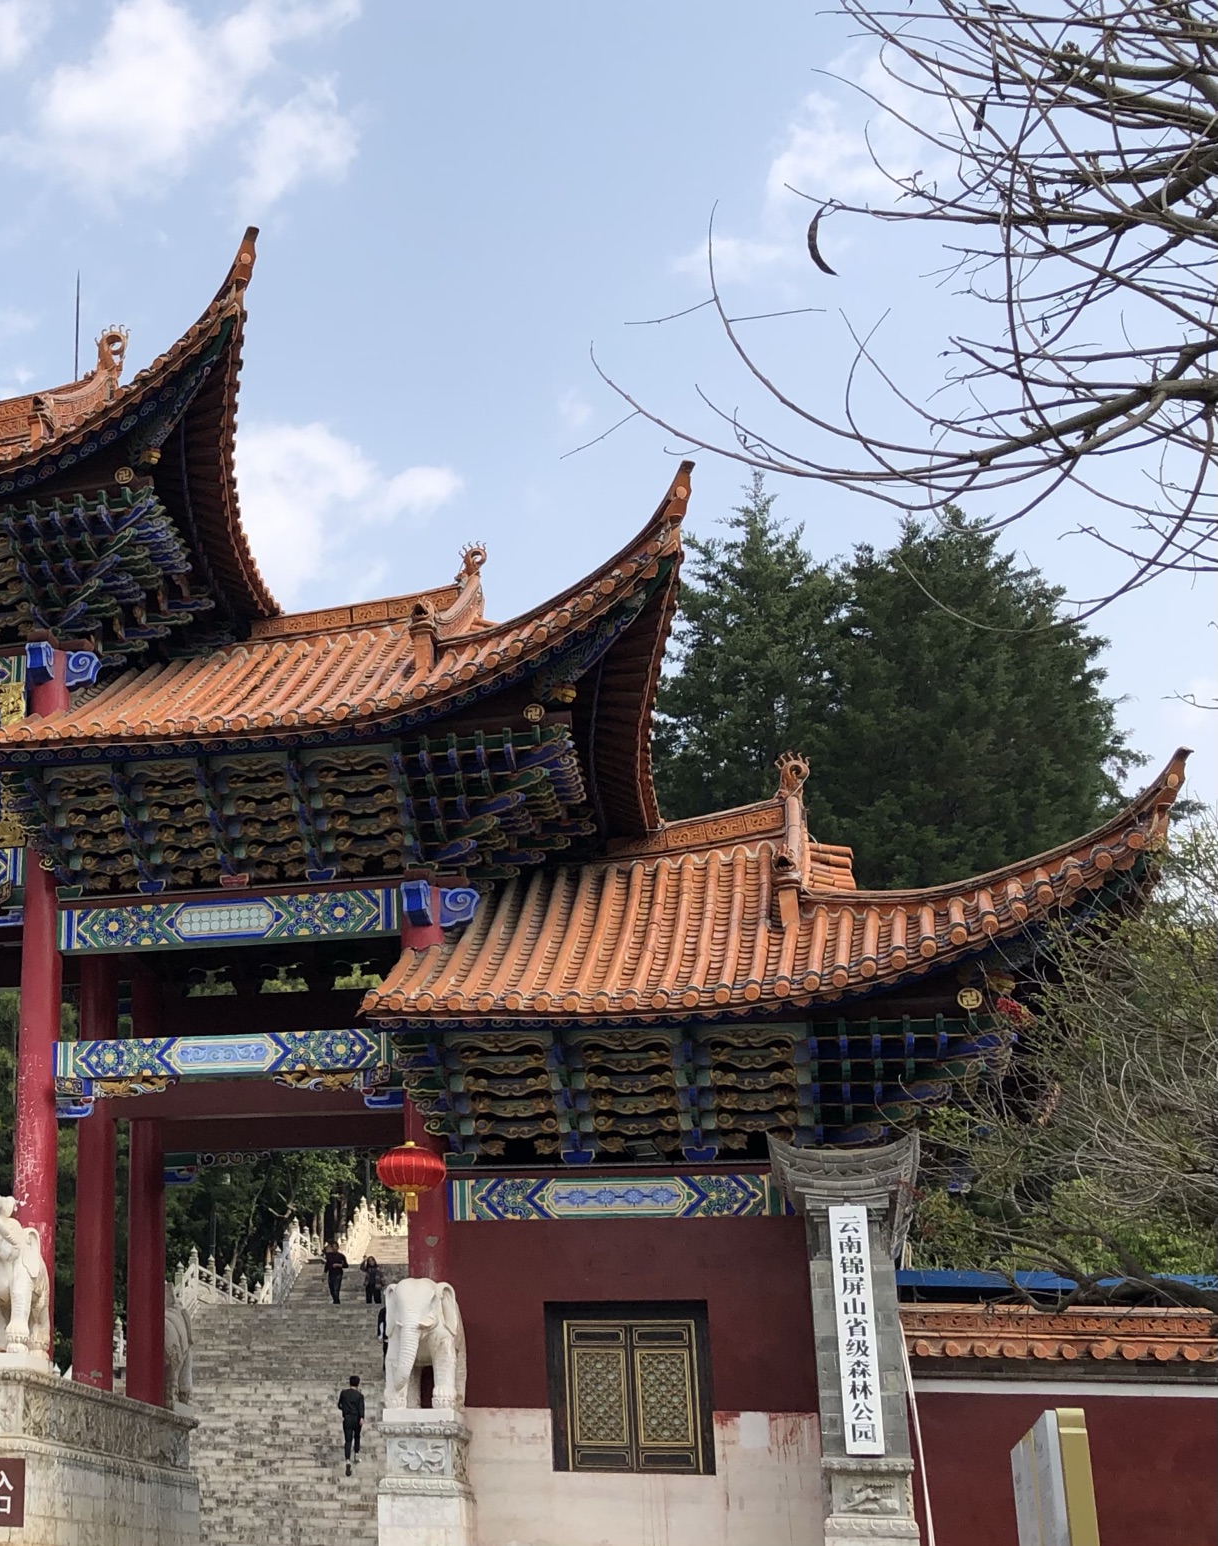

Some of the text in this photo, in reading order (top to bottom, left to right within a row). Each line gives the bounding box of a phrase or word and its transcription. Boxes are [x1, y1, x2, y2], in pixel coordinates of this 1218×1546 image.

[835, 1214, 877, 1444] 云南锦屏山省级森林公园
